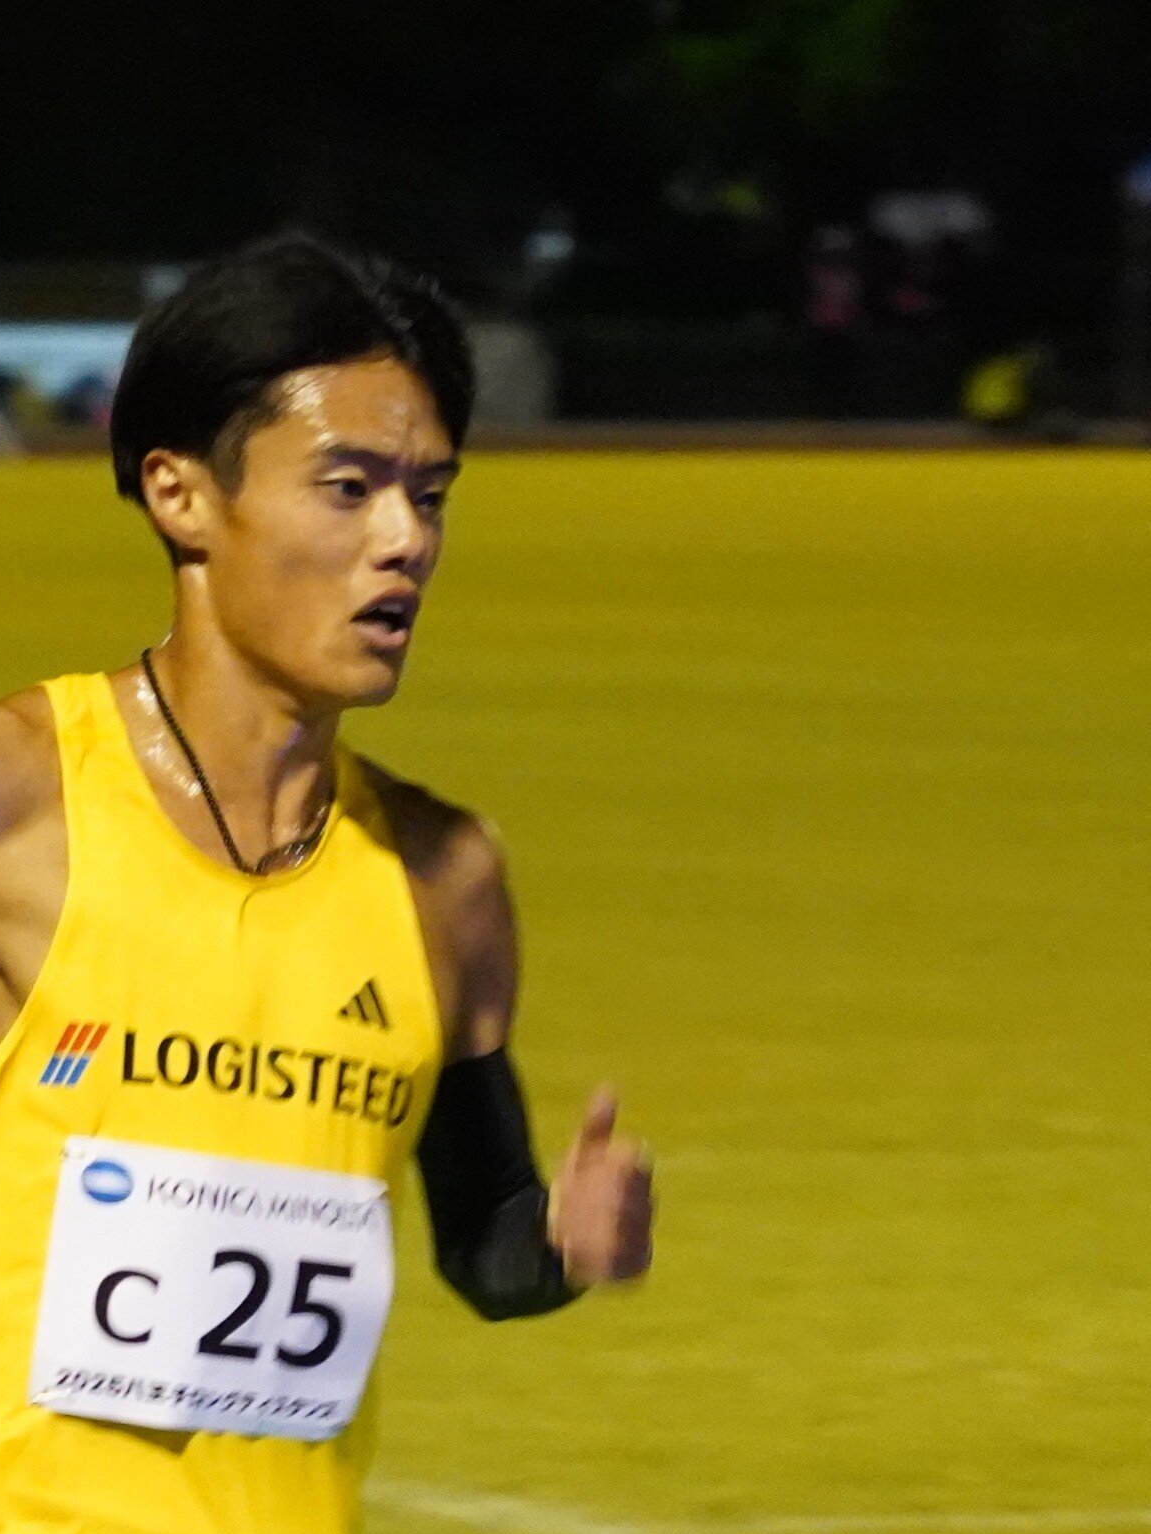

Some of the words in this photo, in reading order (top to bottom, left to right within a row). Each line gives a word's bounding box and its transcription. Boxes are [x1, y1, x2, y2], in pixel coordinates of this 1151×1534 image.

[121, 1028, 414, 1129] LOGISTEED
[147, 1176, 262, 1217] KONICA
[93, 1269, 160, 1344] C
[197, 1248, 357, 1369] 25
